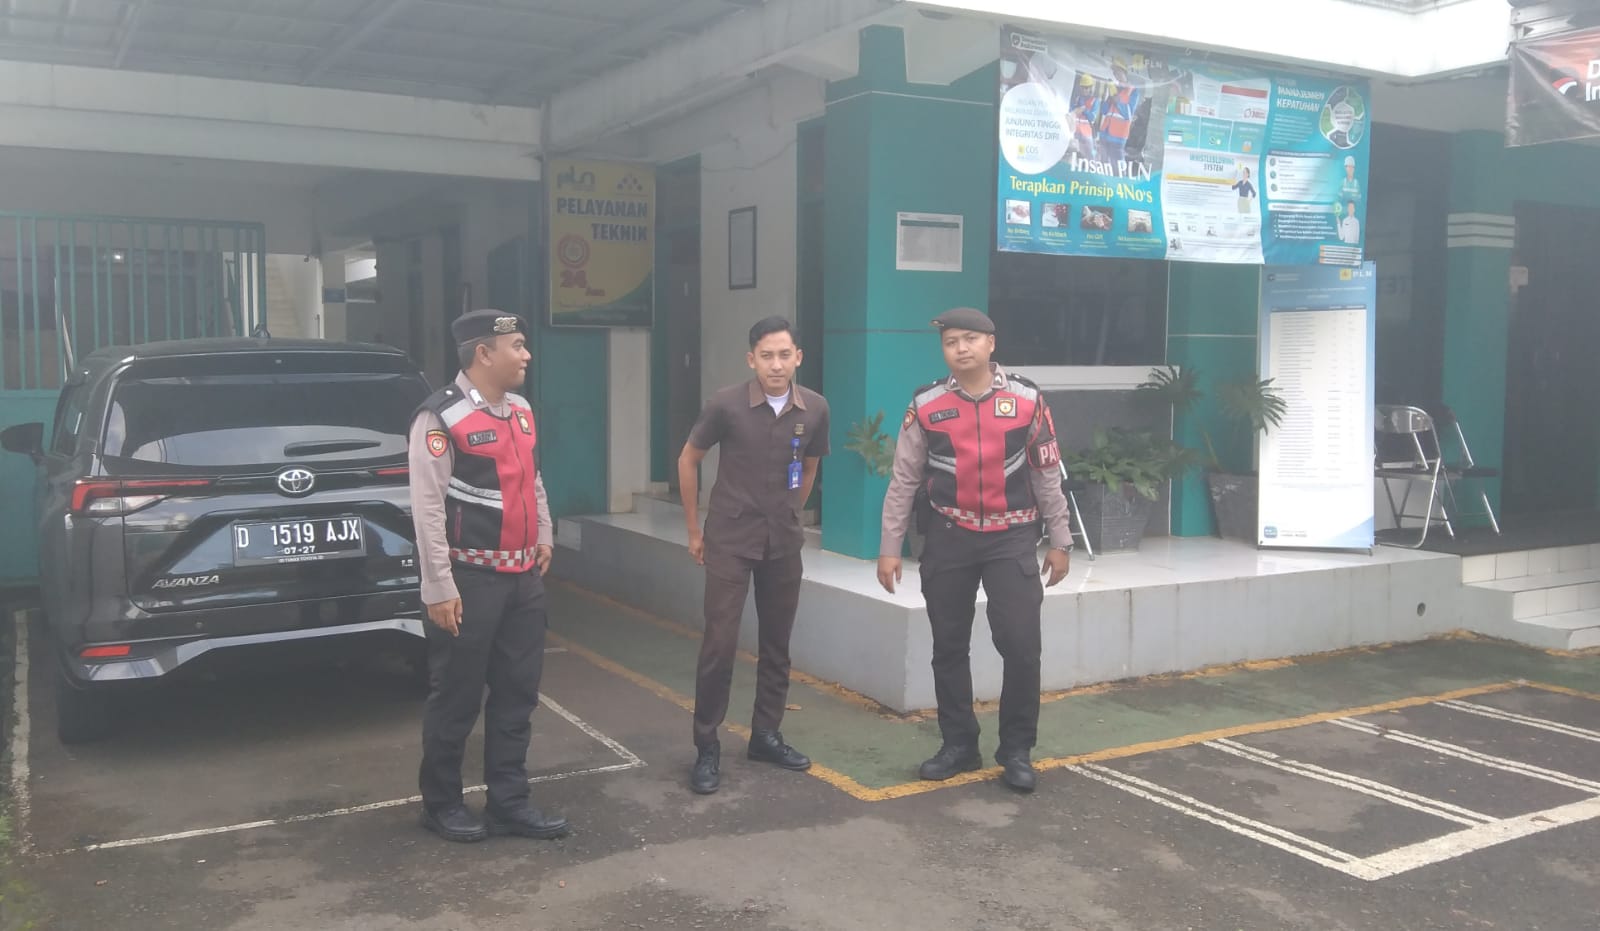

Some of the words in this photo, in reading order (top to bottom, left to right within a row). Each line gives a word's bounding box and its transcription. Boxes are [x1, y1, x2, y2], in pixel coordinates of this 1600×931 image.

[1276, 98, 1320, 112] KEPATUHAN
[1005, 128, 1043, 139] INTEGRITAS
[1070, 151, 1114, 177] Insan
[1118, 161, 1153, 181] PLN
[1010, 176, 1065, 197] Terapkan
[1069, 181, 1114, 202] Prinsip
[1116, 185, 1153, 203] 4No's
[557, 197, 648, 217] PELAYANAN
[592, 223, 648, 241] TEKNIK
[238, 527, 249, 548] D
[270, 523, 315, 545] 1519
[326, 519, 360, 542] AJX
[151, 574, 220, 589] AVANZA
